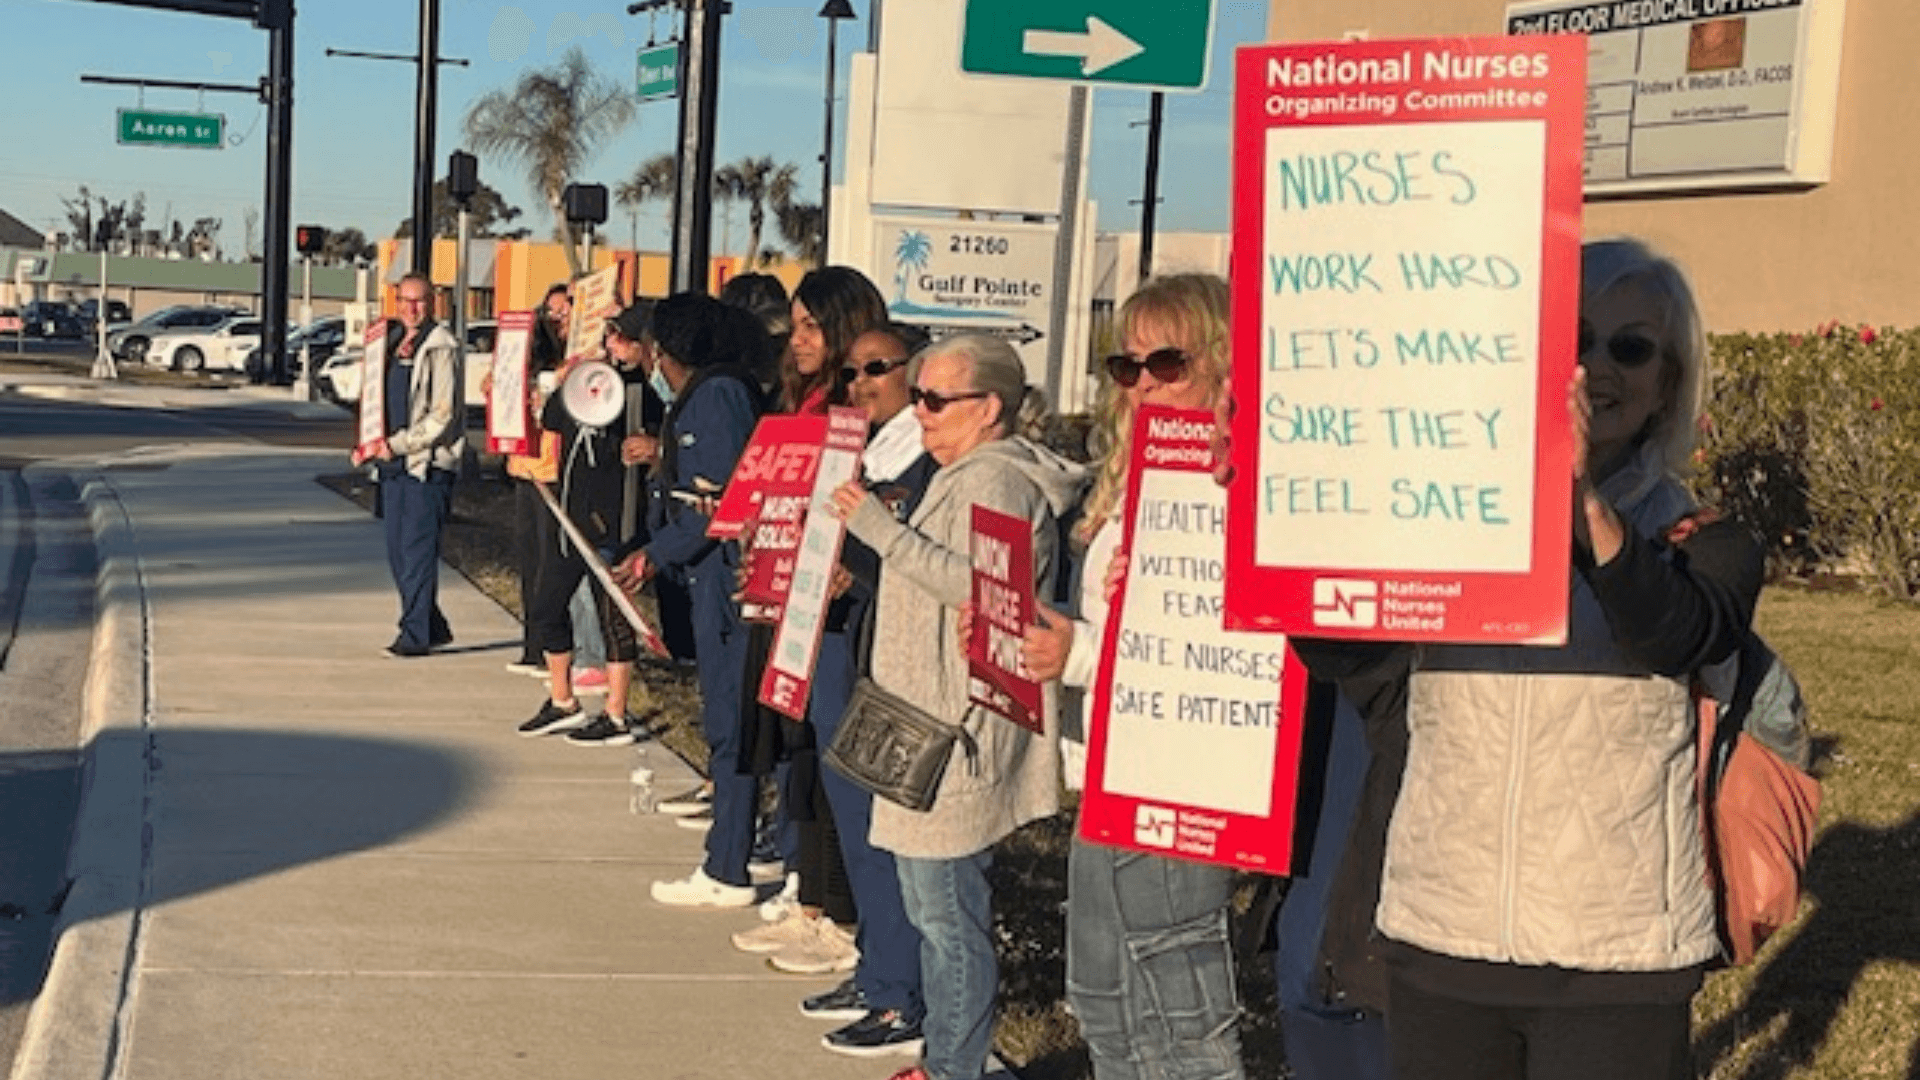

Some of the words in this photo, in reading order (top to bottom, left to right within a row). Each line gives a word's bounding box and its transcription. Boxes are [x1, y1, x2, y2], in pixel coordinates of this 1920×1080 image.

[1548, 8, 1609, 34] FLOOR
[1613, 0, 1698, 27] MEDICAL
[1266, 52, 1411, 88] National
[1423, 50, 1549, 82] Nurses
[1264, 91, 1399, 119] Organizing
[1404, 87, 1549, 112] Committee
[1278, 150, 1477, 210] NURSES
[949, 235, 1009, 255] 21260
[918, 274, 966, 293] Gulf
[973, 276, 1042, 297] Pointe
[1269, 252, 1383, 295] WORK
[1398, 252, 1522, 290] HARD
[1267, 326, 1381, 371] LET'S
[1394, 328, 1524, 366] MAKE
[1147, 416, 1216, 441] Nationa
[1264, 392, 1368, 447] SURE
[1378, 407, 1502, 449] THEY
[736, 443, 823, 482] SAFET
[1142, 499, 1225, 535] HEALTH
[1264, 473, 1371, 516] FEEL
[1390, 477, 1511, 525] SAFE
[1139, 554, 1224, 582] WITHO
[1382, 580, 1463, 597] National
[1381, 600, 1446, 616] Nurses
[1381, 615, 1446, 631] United
[987, 622, 1030, 683] POWE
[1120, 629, 1174, 666] SAFE
[1184, 642, 1286, 684] NURSES
[1114, 682, 1165, 720] SAFE
